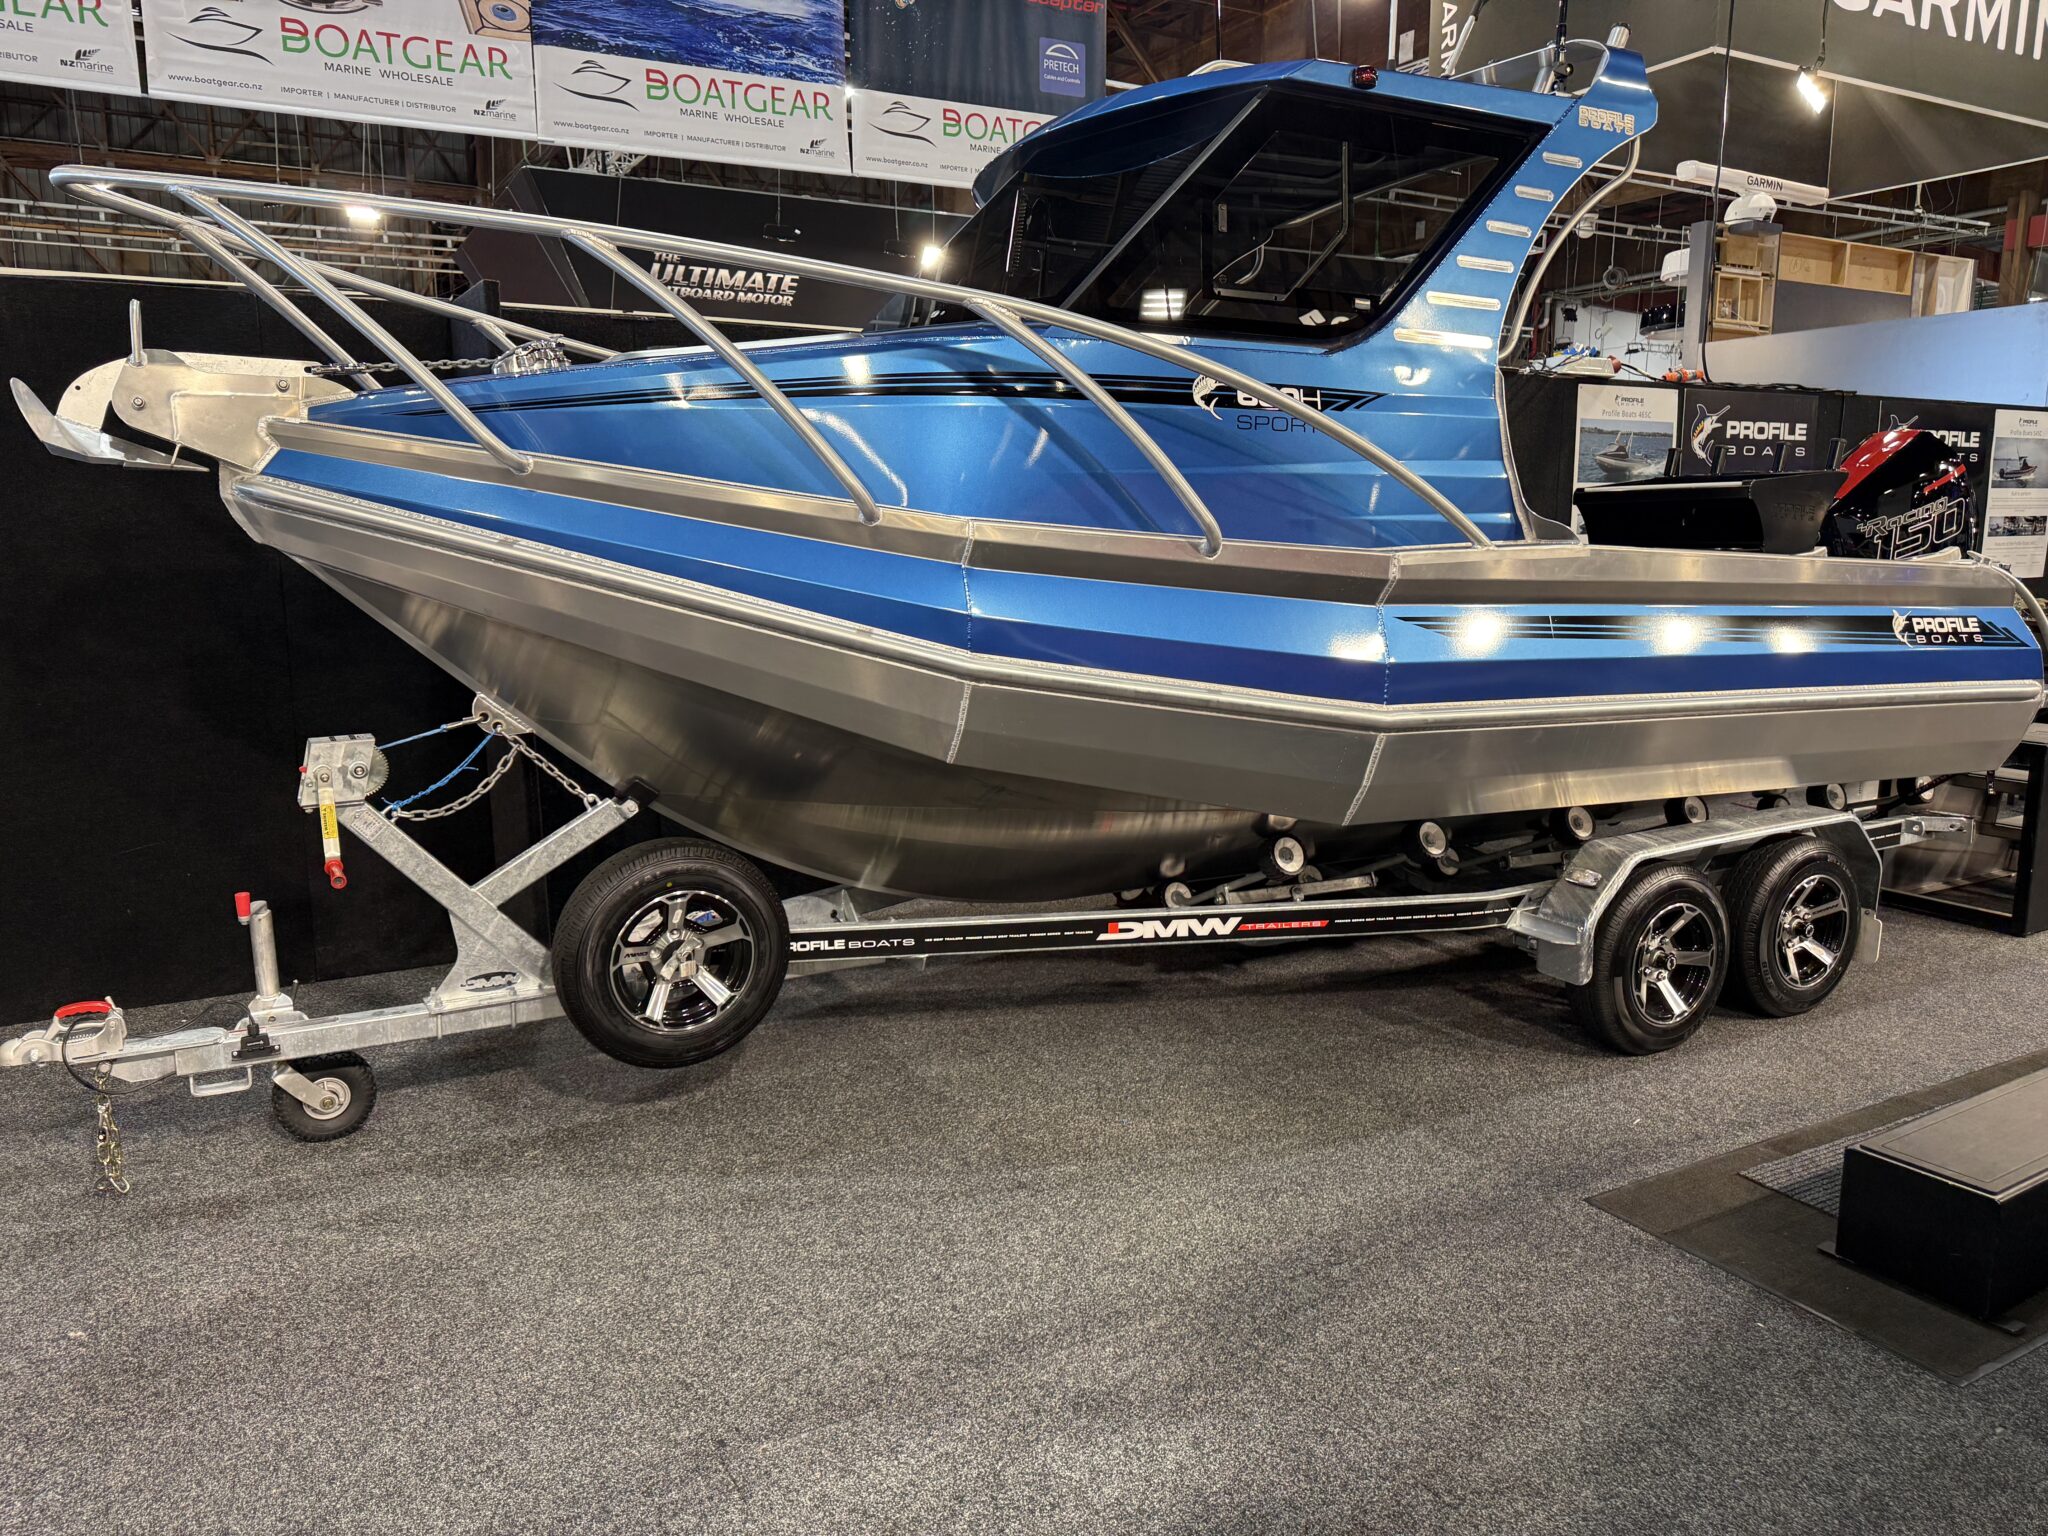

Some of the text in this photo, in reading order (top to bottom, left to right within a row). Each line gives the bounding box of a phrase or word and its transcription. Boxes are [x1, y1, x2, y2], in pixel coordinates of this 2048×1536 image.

[280, 17, 513, 80] BOATGEAR
[324, 62, 454, 86] MARINE WHOLESALE
[1043, 59, 1079, 74] PRETECH
[168, 73, 263, 91] www.boatgear.co.nz
[280, 86, 457, 113] IMPORTER MANUFACTURER DISTRIBUTOR
[645, 68, 833, 121] BOATGEAR
[679, 108, 784, 128] MARINE WHOLESALE
[553, 120, 629, 135] www.boatgear.co.nz
[644, 130, 786, 151] IMPORTER MANUFACTURER DISTRIBUTOR
[969, 143, 1001, 154] MARINE
[866, 155, 928, 169] www.boatgear.co.nz
[940, 164, 968, 173] IMPORTER
[1746, 175, 1783, 191] GARMIN
[654, 251, 681, 263] THE
[650, 262, 799, 296] ULTIMATE
[667, 285, 793, 306] TBOARD MOTOR
[1726, 420, 1807, 440] PROFILE
[1726, 445, 1806, 457] BOAS
[1874, 498, 1966, 561] 150
[1912, 617, 1981, 633] PROFILE
[1915, 634, 1983, 644] BOATS
[1096, 916, 1322, 941] DMW TRAILERS
[790, 938, 915, 952] ROFILE BOATS
